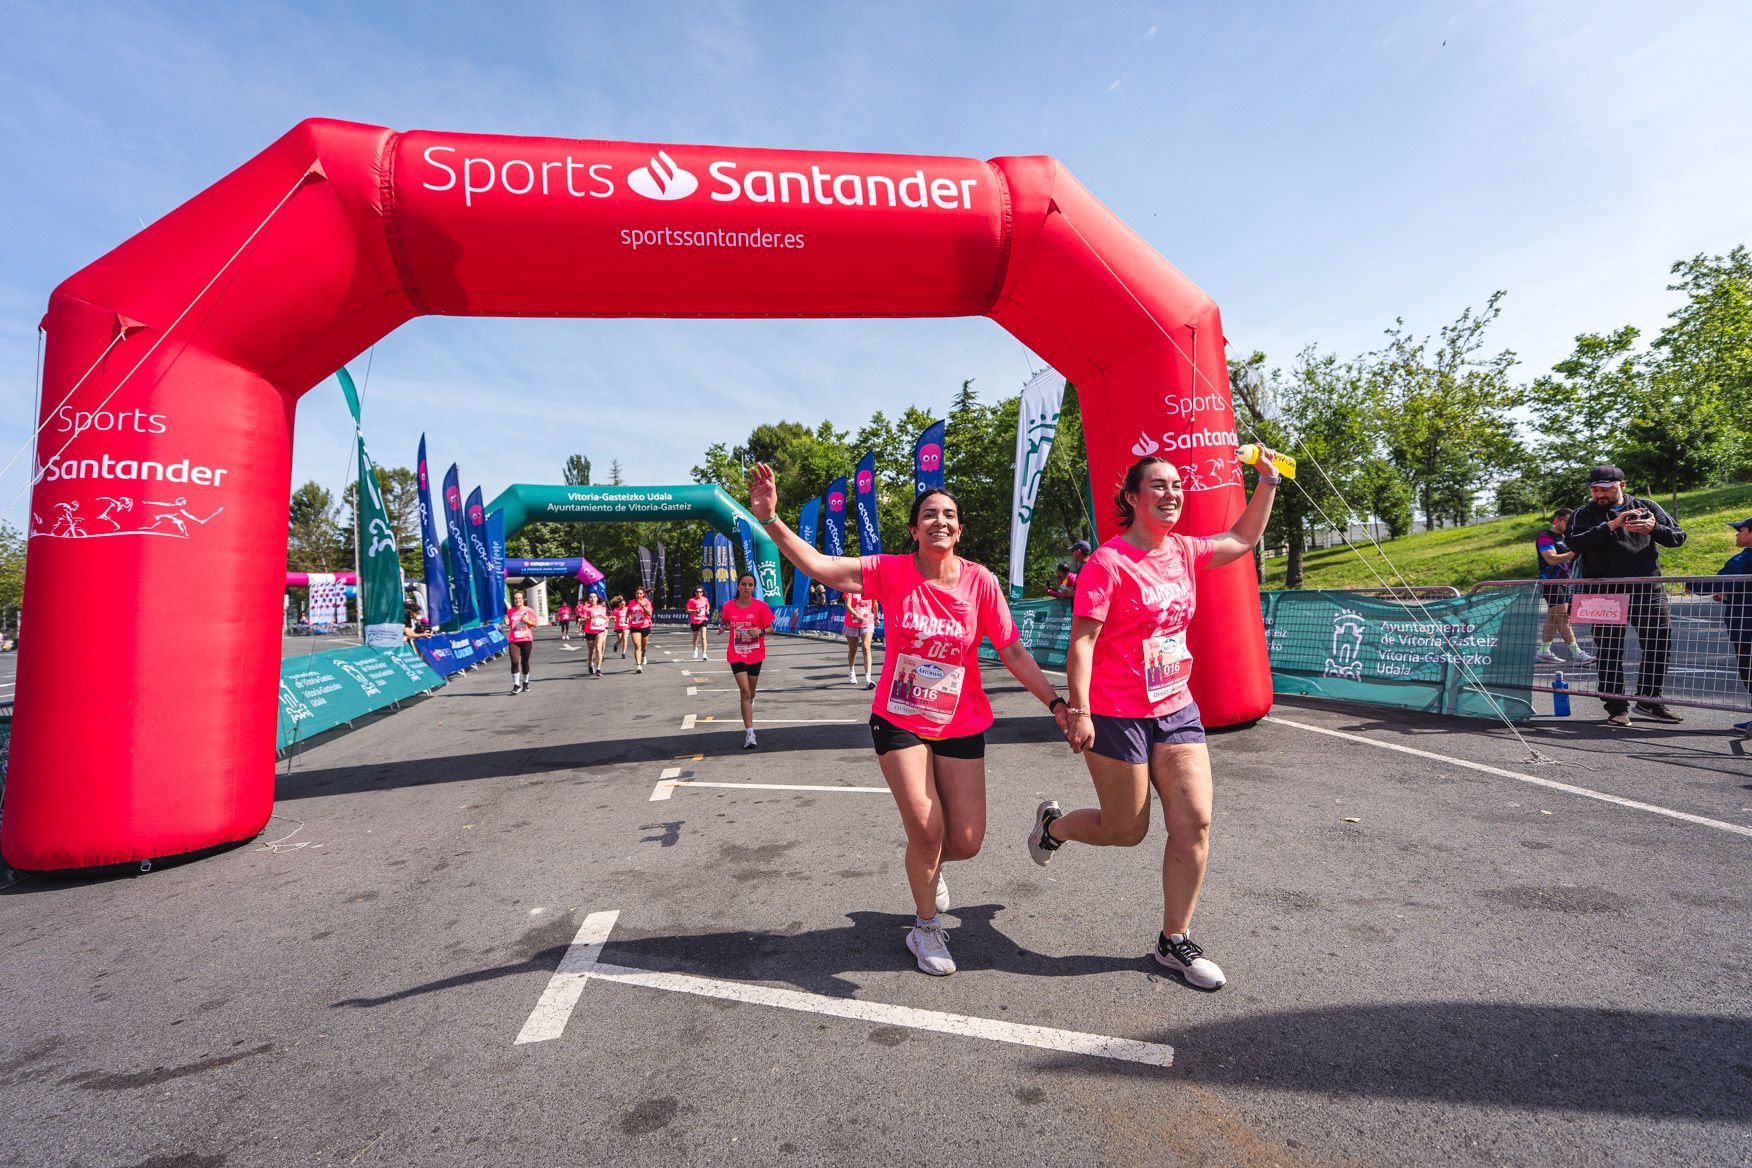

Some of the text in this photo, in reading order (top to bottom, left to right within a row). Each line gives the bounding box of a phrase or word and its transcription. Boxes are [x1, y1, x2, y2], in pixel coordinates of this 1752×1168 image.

[422, 146, 977, 209] Sports Santander
[621, 227, 805, 250] sportssantander.es
[1165, 393, 1225, 418] Sports
[57, 405, 167, 438] Sports
[47, 454, 228, 487] Santander
[567, 492, 673, 501] Vitoria-Gasteizko Udala
[547, 502, 692, 512] Ayuntamiento de Vitoria-Gasteiz
[858, 502, 879, 544] octopus
[825, 518, 844, 556] octopus
[1142, 580, 1188, 605] CARRERA
[1579, 609, 1618, 618] EVENTOS
[902, 612, 963, 637] CARRERA
[1380, 621, 1475, 633] Ayuntamiento
[1380, 635, 1498, 647] de Vitoria-Gasteiz
[1378, 650, 1492, 665] Vitoria-Gasteizko
[1163, 662, 1180, 675] 016
[1376, 662, 1411, 676] Udala
[912, 686, 938, 700] 016
